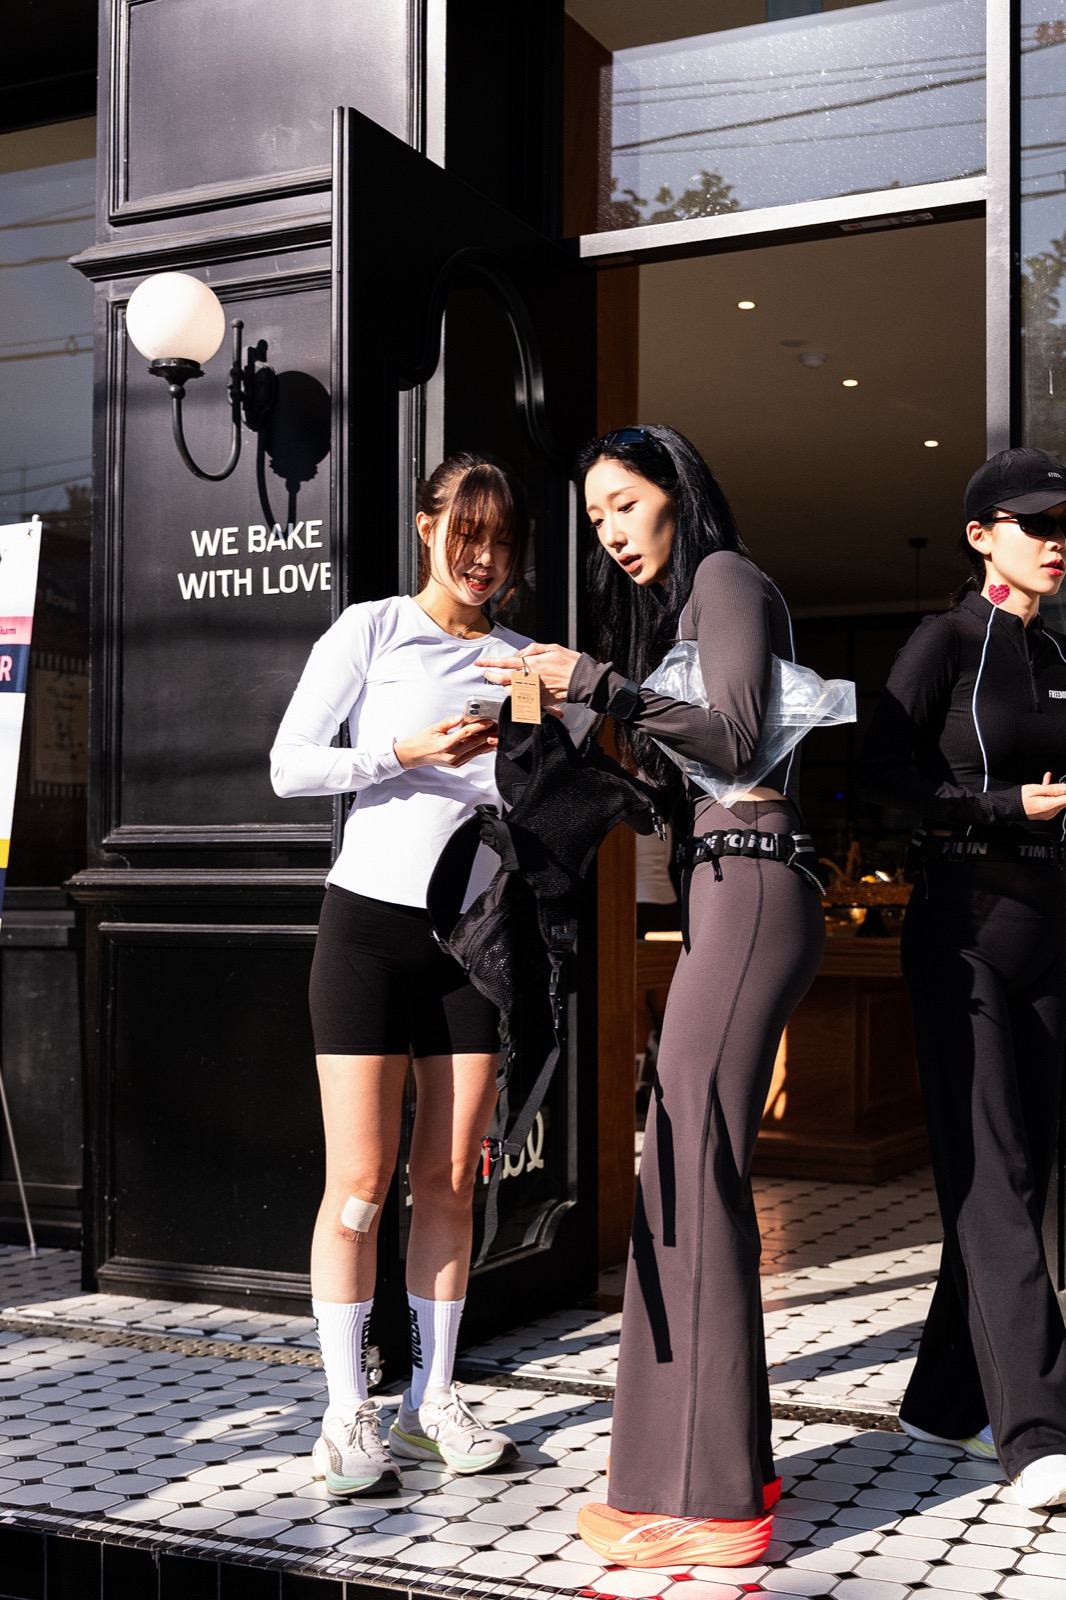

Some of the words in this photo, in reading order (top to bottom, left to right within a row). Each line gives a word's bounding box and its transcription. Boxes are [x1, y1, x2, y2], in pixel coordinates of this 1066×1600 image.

[191, 527, 239, 557] WE
[248, 520, 323, 553] BAKE
[177, 567, 253, 600] WITH
[263, 561, 331, 595] LOVE
